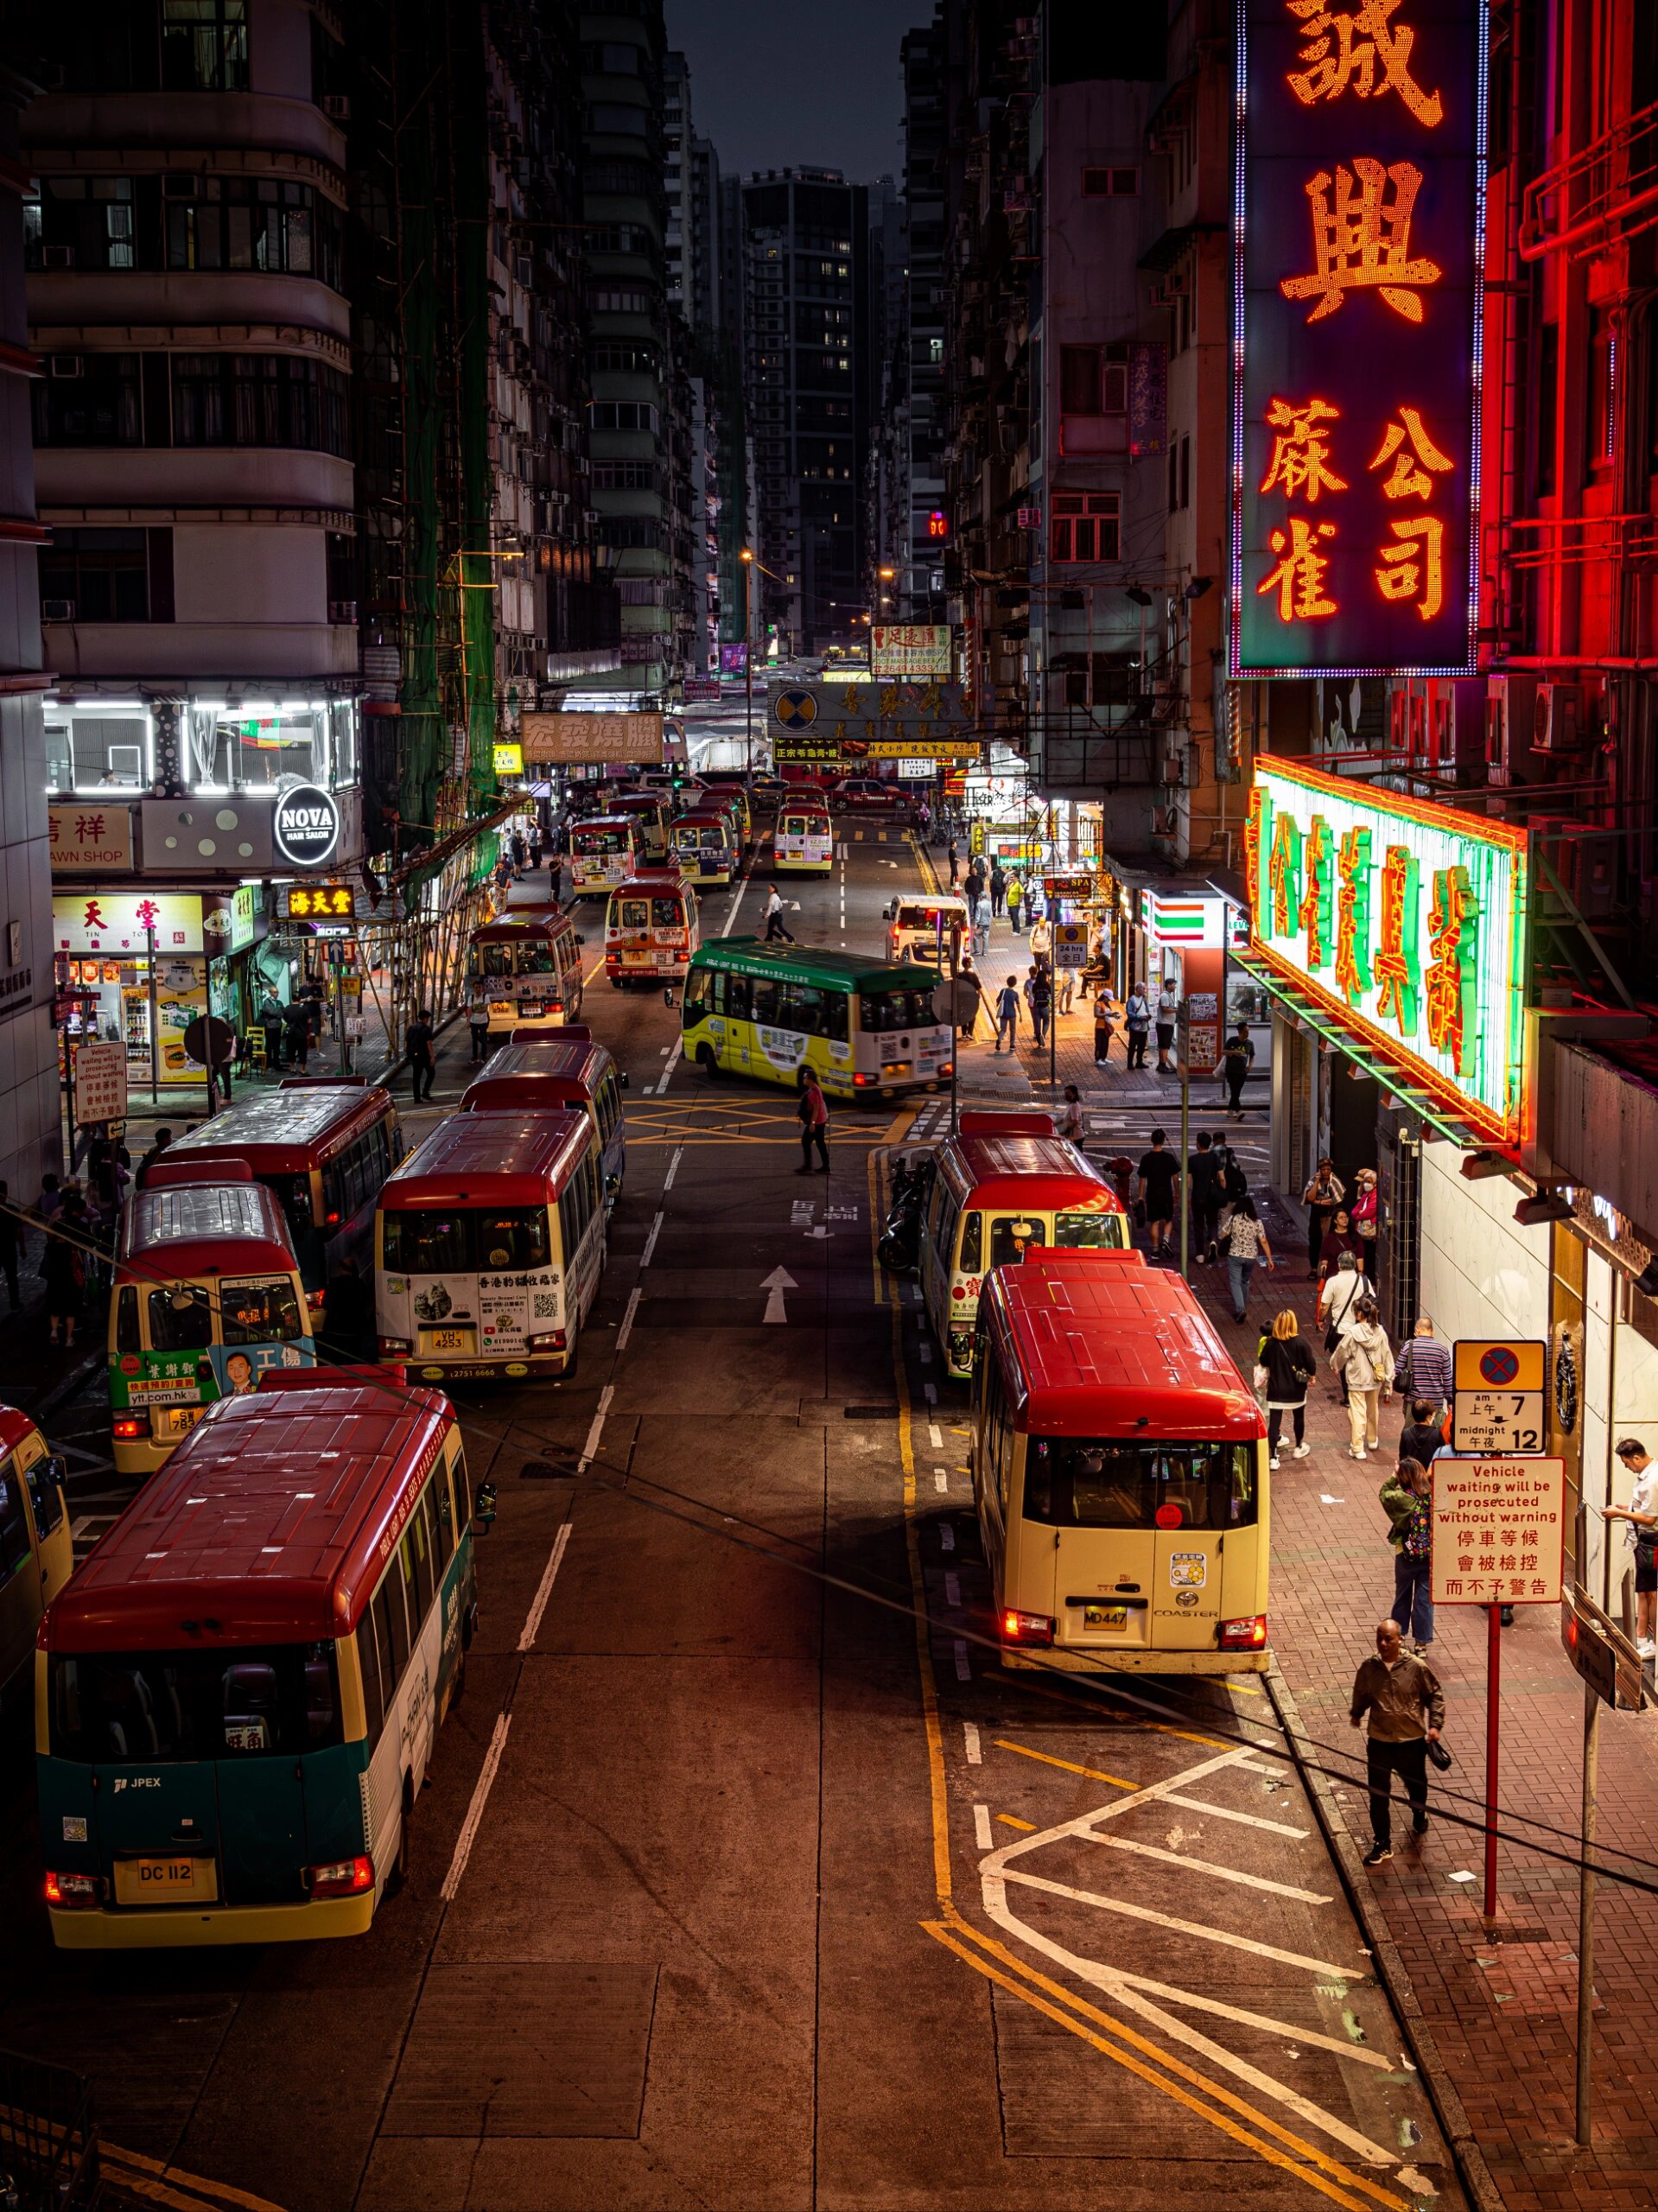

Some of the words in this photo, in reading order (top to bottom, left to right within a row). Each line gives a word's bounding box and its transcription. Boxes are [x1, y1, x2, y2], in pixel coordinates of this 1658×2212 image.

[1369, 407, 1455, 620] 公司
[282, 808, 333, 828] NOVA
[287, 832, 304, 841] HAIR
[84, 851, 122, 862] SHOP
[290, 890, 351, 913] 海天堂
[1062, 953, 1081, 963] 全日
[86, 1063, 117, 1072] prosecuted
[86, 1080, 118, 1092] 停車等候
[83, 1105, 121, 1119] 而不予警告
[441, 1332, 455, 1340] VH
[435, 1338, 462, 1348] 4253
[257, 1348, 302, 1369] 工傷
[148, 1363, 194, 1379] 葉謝鄧
[131, 1390, 187, 1404] ytt.com.hk
[1470, 1404, 1496, 1416] 上午
[1511, 1396, 1525, 1416] 7
[180, 1411, 194, 1420] SW
[1459, 1426, 1505, 1436] midnight
[1512, 1430, 1538, 1449] 12
[1470, 1437, 1495, 1448] 午夜
[1473, 1465, 1525, 1477] Vehicle
[1447, 1481, 1500, 1494] waiting
[1505, 1481, 1529, 1492] will
[1534, 1481, 1550, 1492] be
[1458, 1497, 1539, 1510] prosecuted
[1439, 1512, 1495, 1522] without
[1500, 1512, 1556, 1524] warning
[1458, 1530, 1539, 1547] 停車等候
[1458, 1554, 1538, 1572] 會被檢控
[1445, 1580, 1547, 1596] 而不予警告
[1086, 1611, 1126, 1624] MD447
[228, 1732, 261, 1749] 旺角
[131, 1777, 161, 1789] JPEX
[140, 1866, 164, 1881] DC
[168, 1866, 191, 1880] 112
